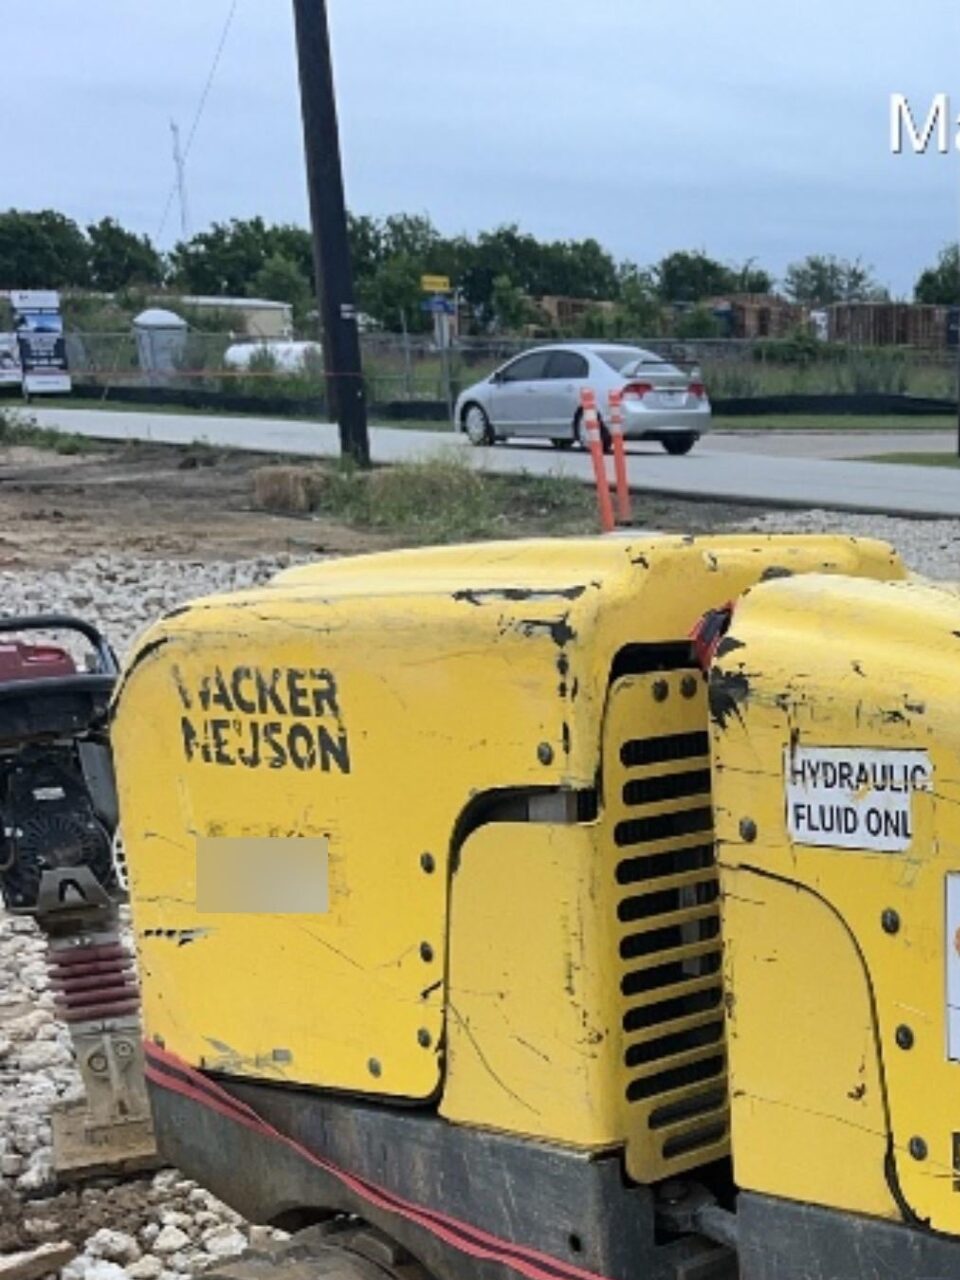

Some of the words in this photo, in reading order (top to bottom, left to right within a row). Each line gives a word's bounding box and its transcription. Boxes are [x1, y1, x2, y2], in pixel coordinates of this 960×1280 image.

[172, 664, 341, 718] ACKER
[790, 759, 929, 793] HYDRAULIC
[793, 803, 858, 834] FLUID
[866, 807, 912, 840] ONL
